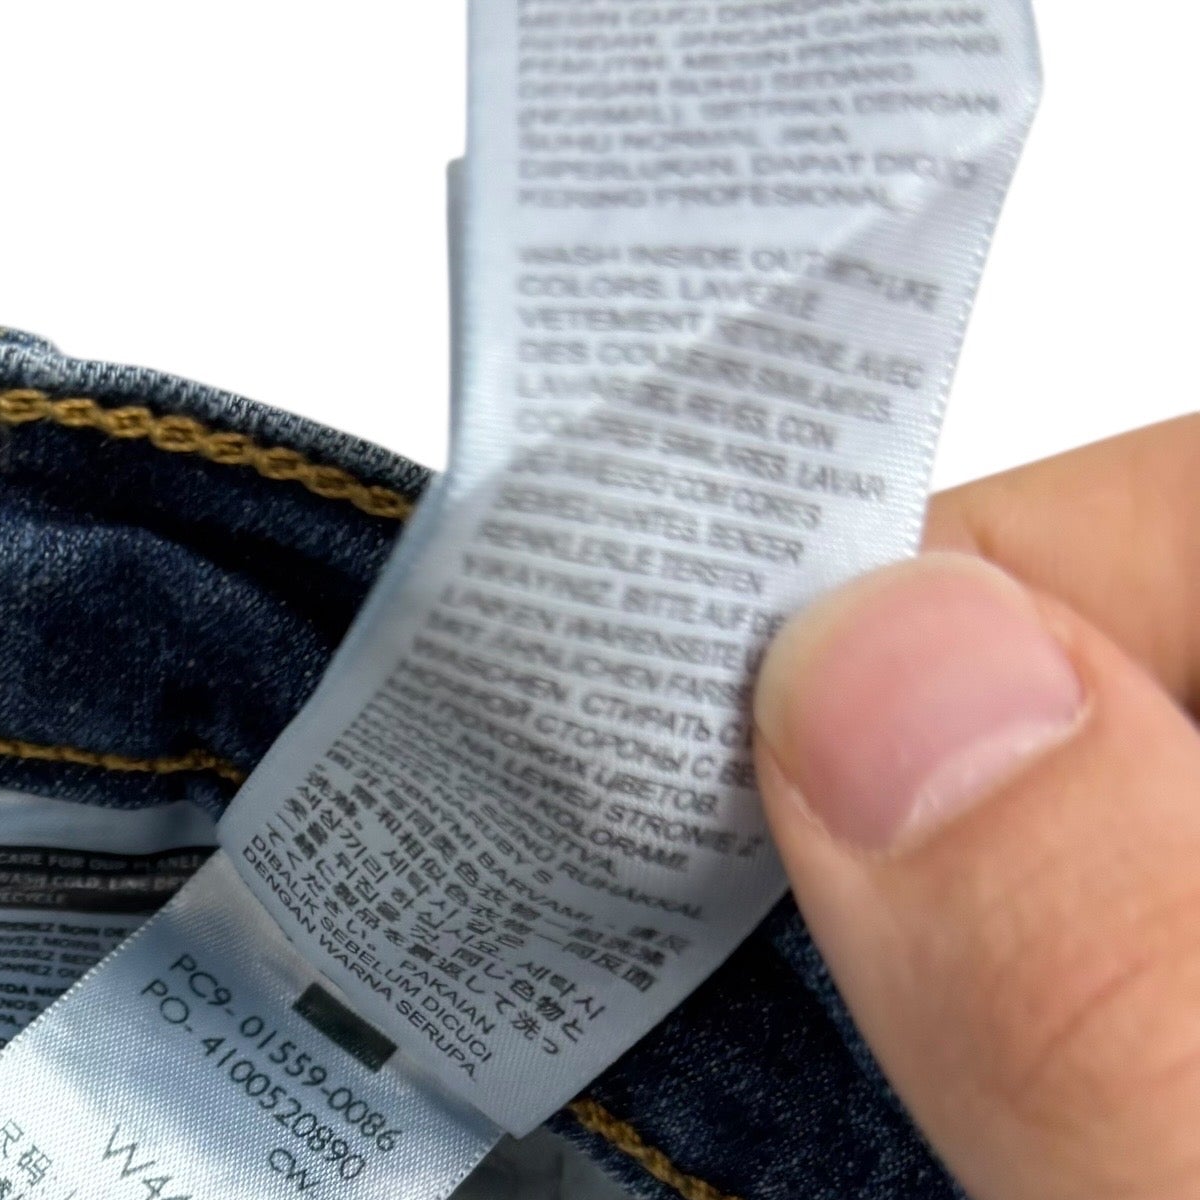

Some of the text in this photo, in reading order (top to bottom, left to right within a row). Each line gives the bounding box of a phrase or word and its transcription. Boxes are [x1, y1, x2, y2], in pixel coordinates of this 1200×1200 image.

[241, 846, 482, 1082] DENGAN WARNA SERUPA.
[250, 834, 493, 1063] DIBALIK SEBELUM DICUCI
[399, 958, 496, 1035] PAKAIAN
[196, 1026, 367, 1184] 4100520890
